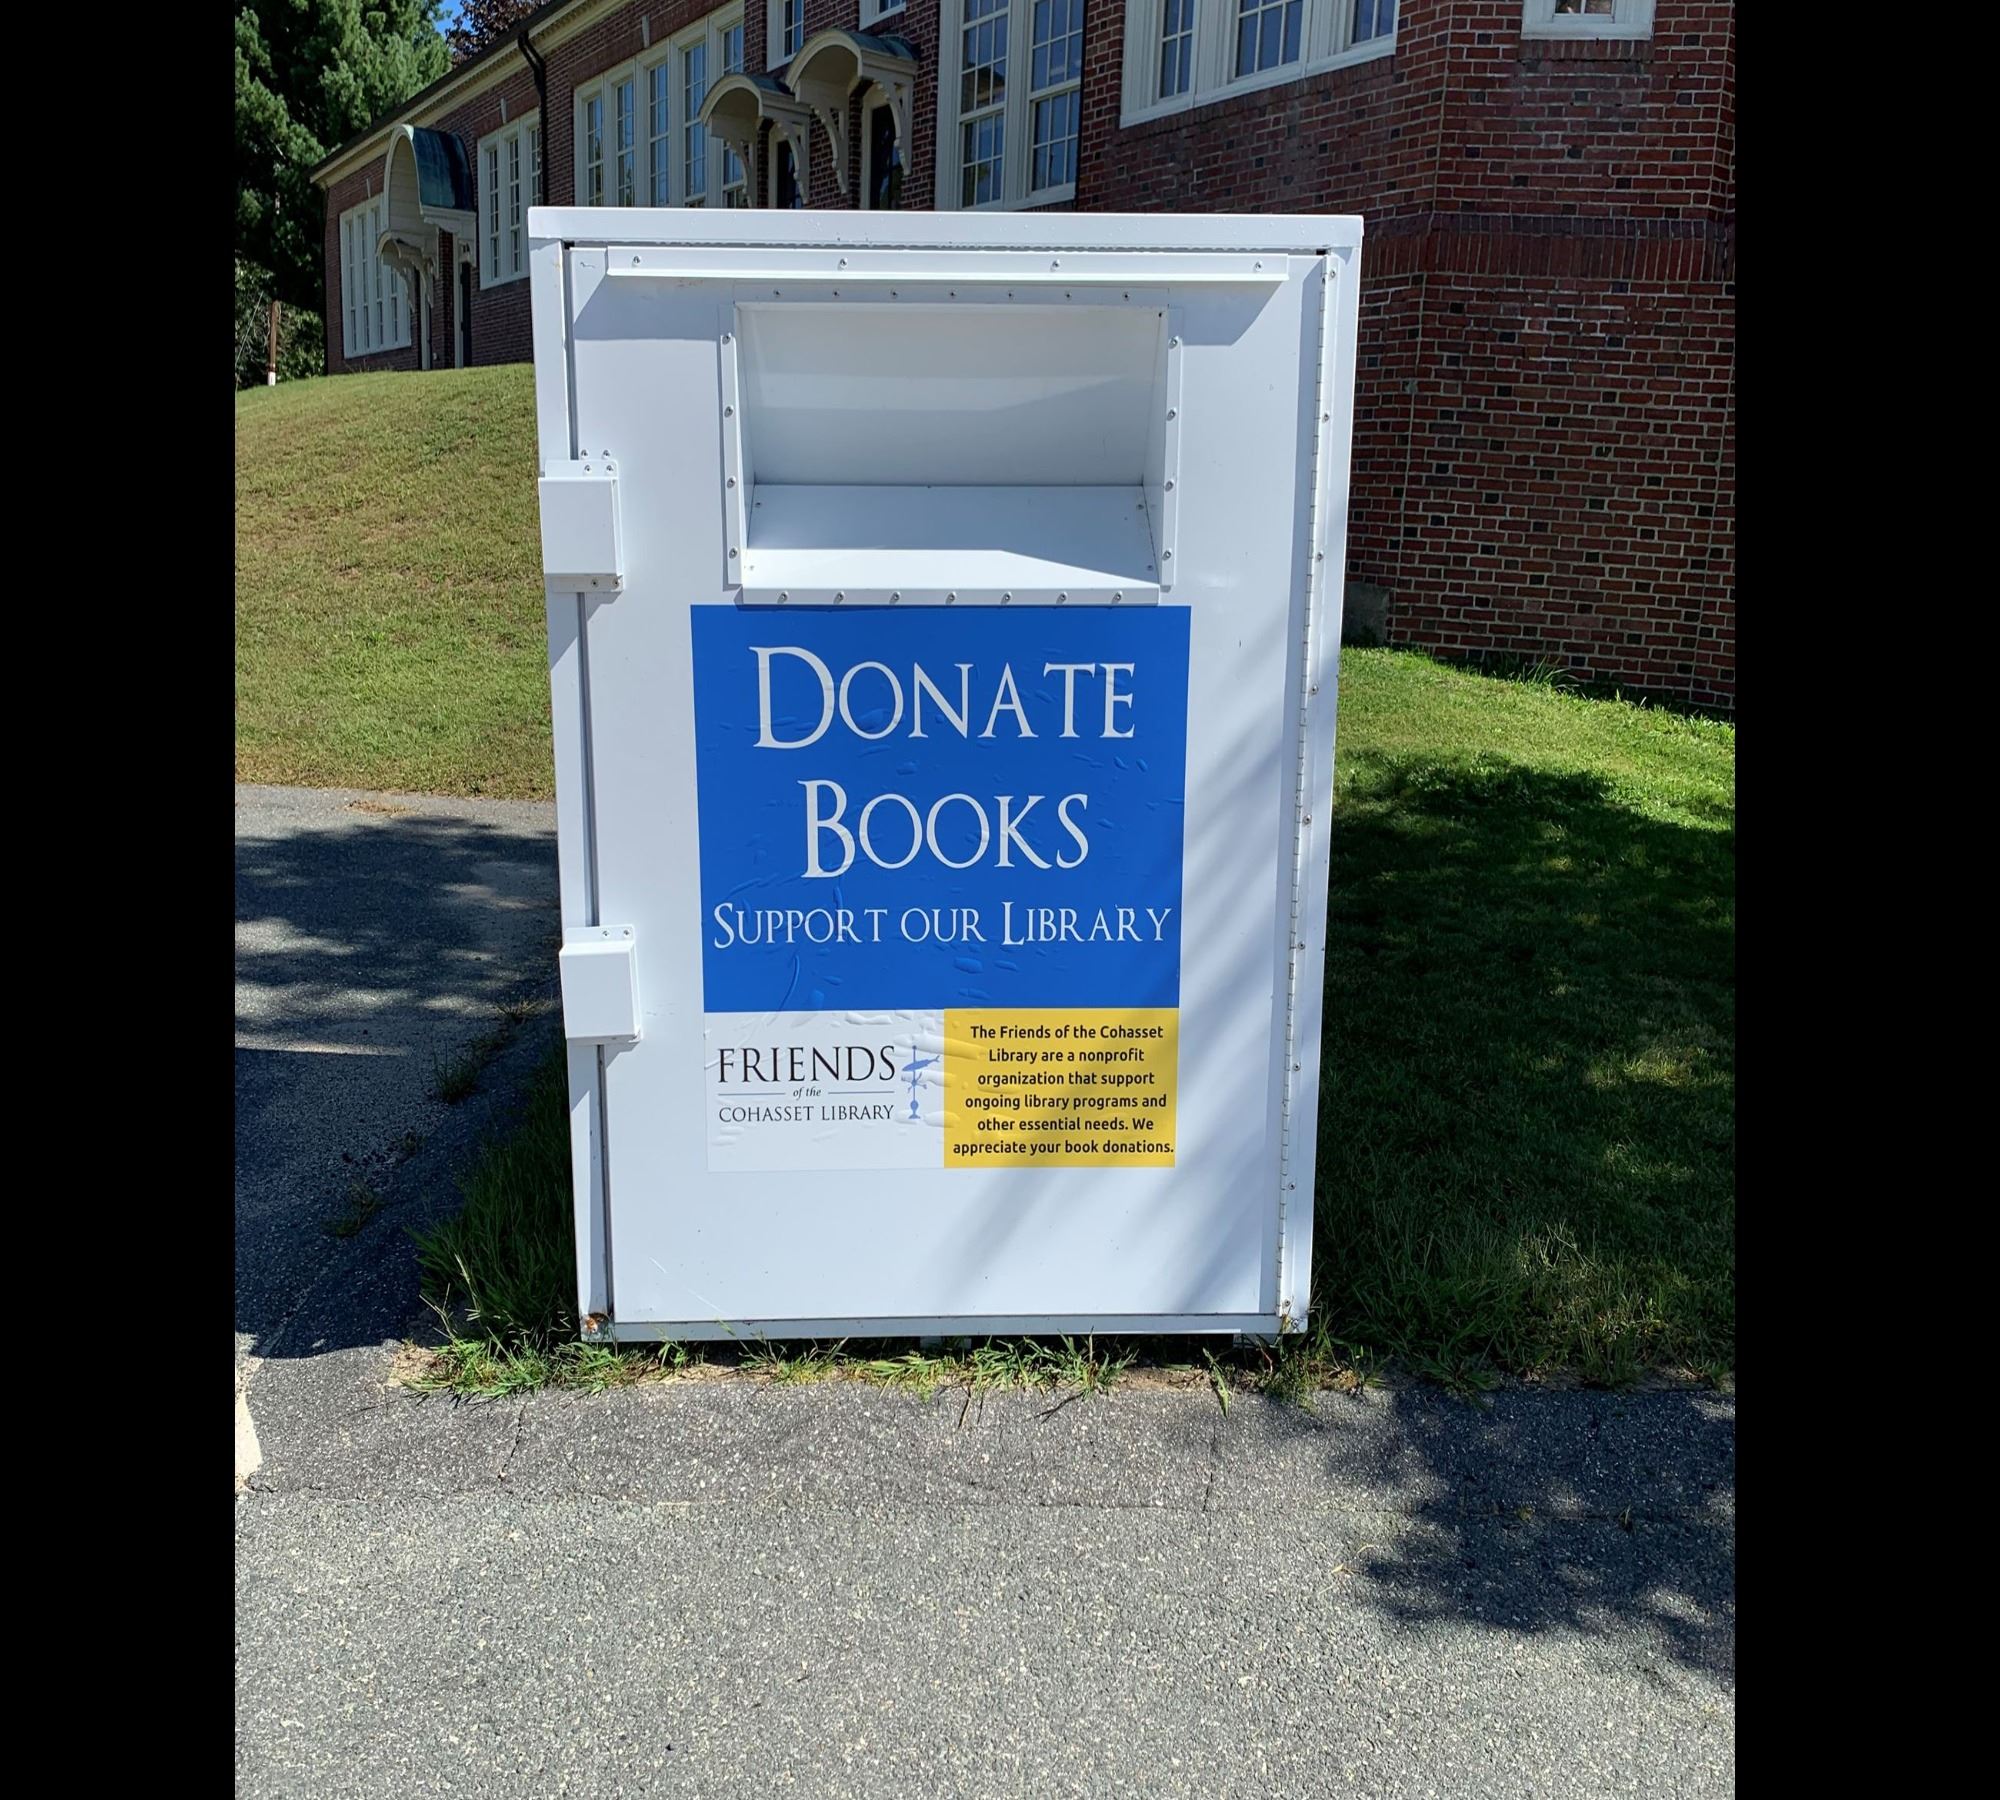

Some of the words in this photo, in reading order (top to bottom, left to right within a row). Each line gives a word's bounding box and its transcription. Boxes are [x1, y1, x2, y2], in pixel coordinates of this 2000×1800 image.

[748, 646, 1135, 749] DONATE
[797, 780, 1089, 879] BOOKS
[713, 903, 887, 948] SUPPORT
[901, 907, 986, 942] OUR
[1001, 901, 1171, 946] LIBRARY
[971, 1025, 995, 1038] The
[1000, 1025, 1050, 1038] Friends
[1055, 1025, 1069, 1038] of
[1073, 1025, 1096, 1038] the
[1100, 1025, 1163, 1038] Cohasset
[718, 1046, 895, 1082] FRIENDS
[989, 1049, 1037, 1064] Library
[1042, 1052, 1062, 1061] are
[1068, 1052, 1073, 1061] a
[1079, 1048, 1144, 1063] nonprofit
[978, 1072, 1064, 1087] organization
[1069, 1072, 1097, 1085] that
[1101, 1073, 1154, 1087] support
[793, 1087, 802, 1100] of
[805, 1087, 821, 1097] the
[966, 1095, 1020, 1110] ongoing
[1025, 1095, 1069, 1110] library
[1073, 1098, 1137, 1109] programs
[1142, 1094, 1166, 1107] and
[719, 1106, 814, 1122] COHASSET
[822, 1105, 894, 1120] LIBRARY
[977, 1118, 1015, 1130] other
[1019, 1117, 1080, 1130] essential
[1085, 1118, 1128, 1130] needs.
[1132, 1118, 1153, 1130] We
[953, 1141, 1026, 1156] appreciate
[1030, 1143, 1060, 1156] your
[1065, 1141, 1098, 1153] book
[1103, 1140, 1173, 1153] donations.
